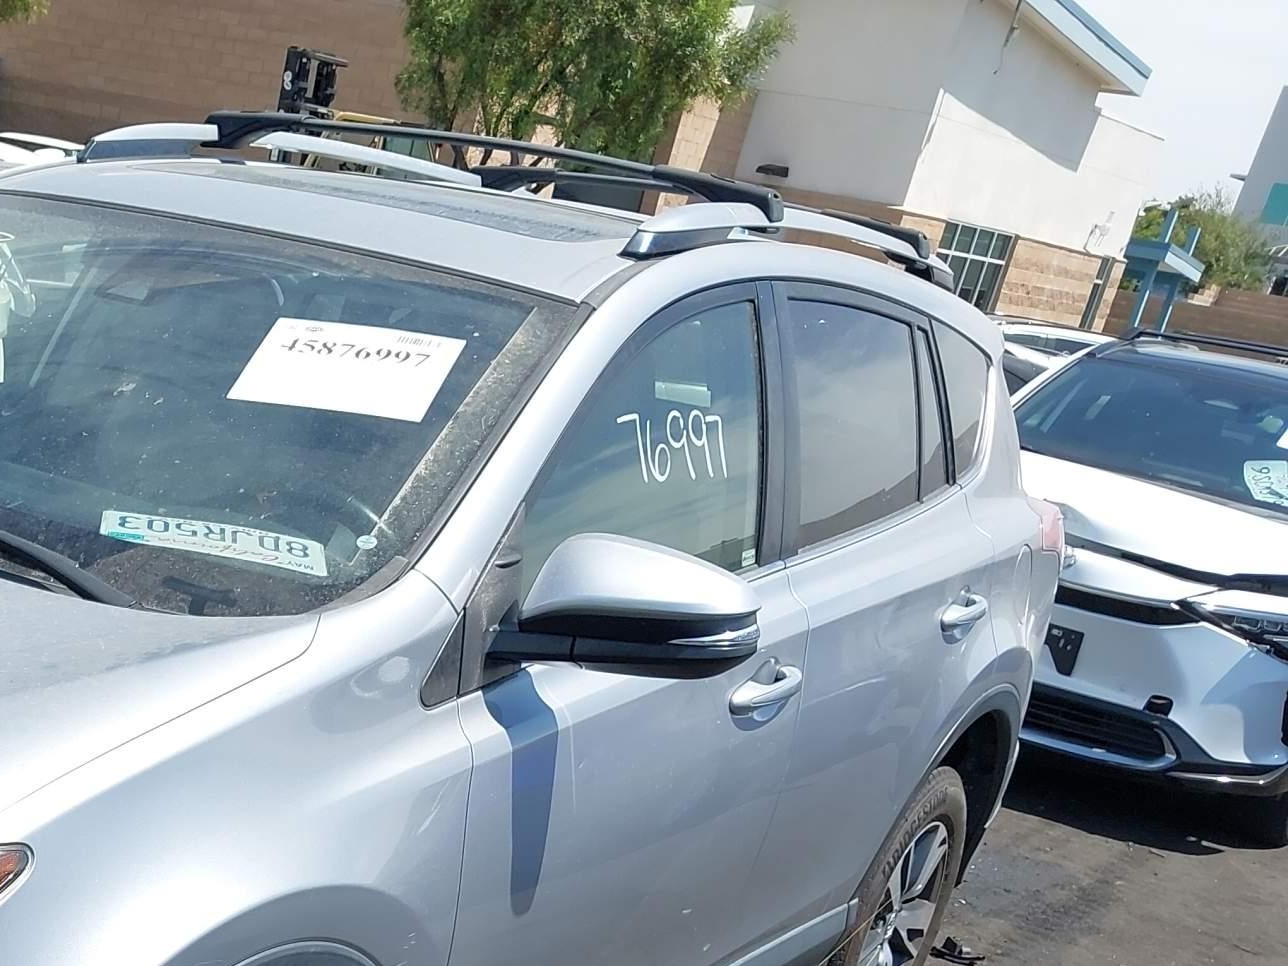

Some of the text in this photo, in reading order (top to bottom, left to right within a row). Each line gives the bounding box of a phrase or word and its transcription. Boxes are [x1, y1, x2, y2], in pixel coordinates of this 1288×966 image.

[280, 337, 432, 367] 45876997
[616, 409, 728, 483] 76997
[118, 515, 310, 559] 8DJR503
